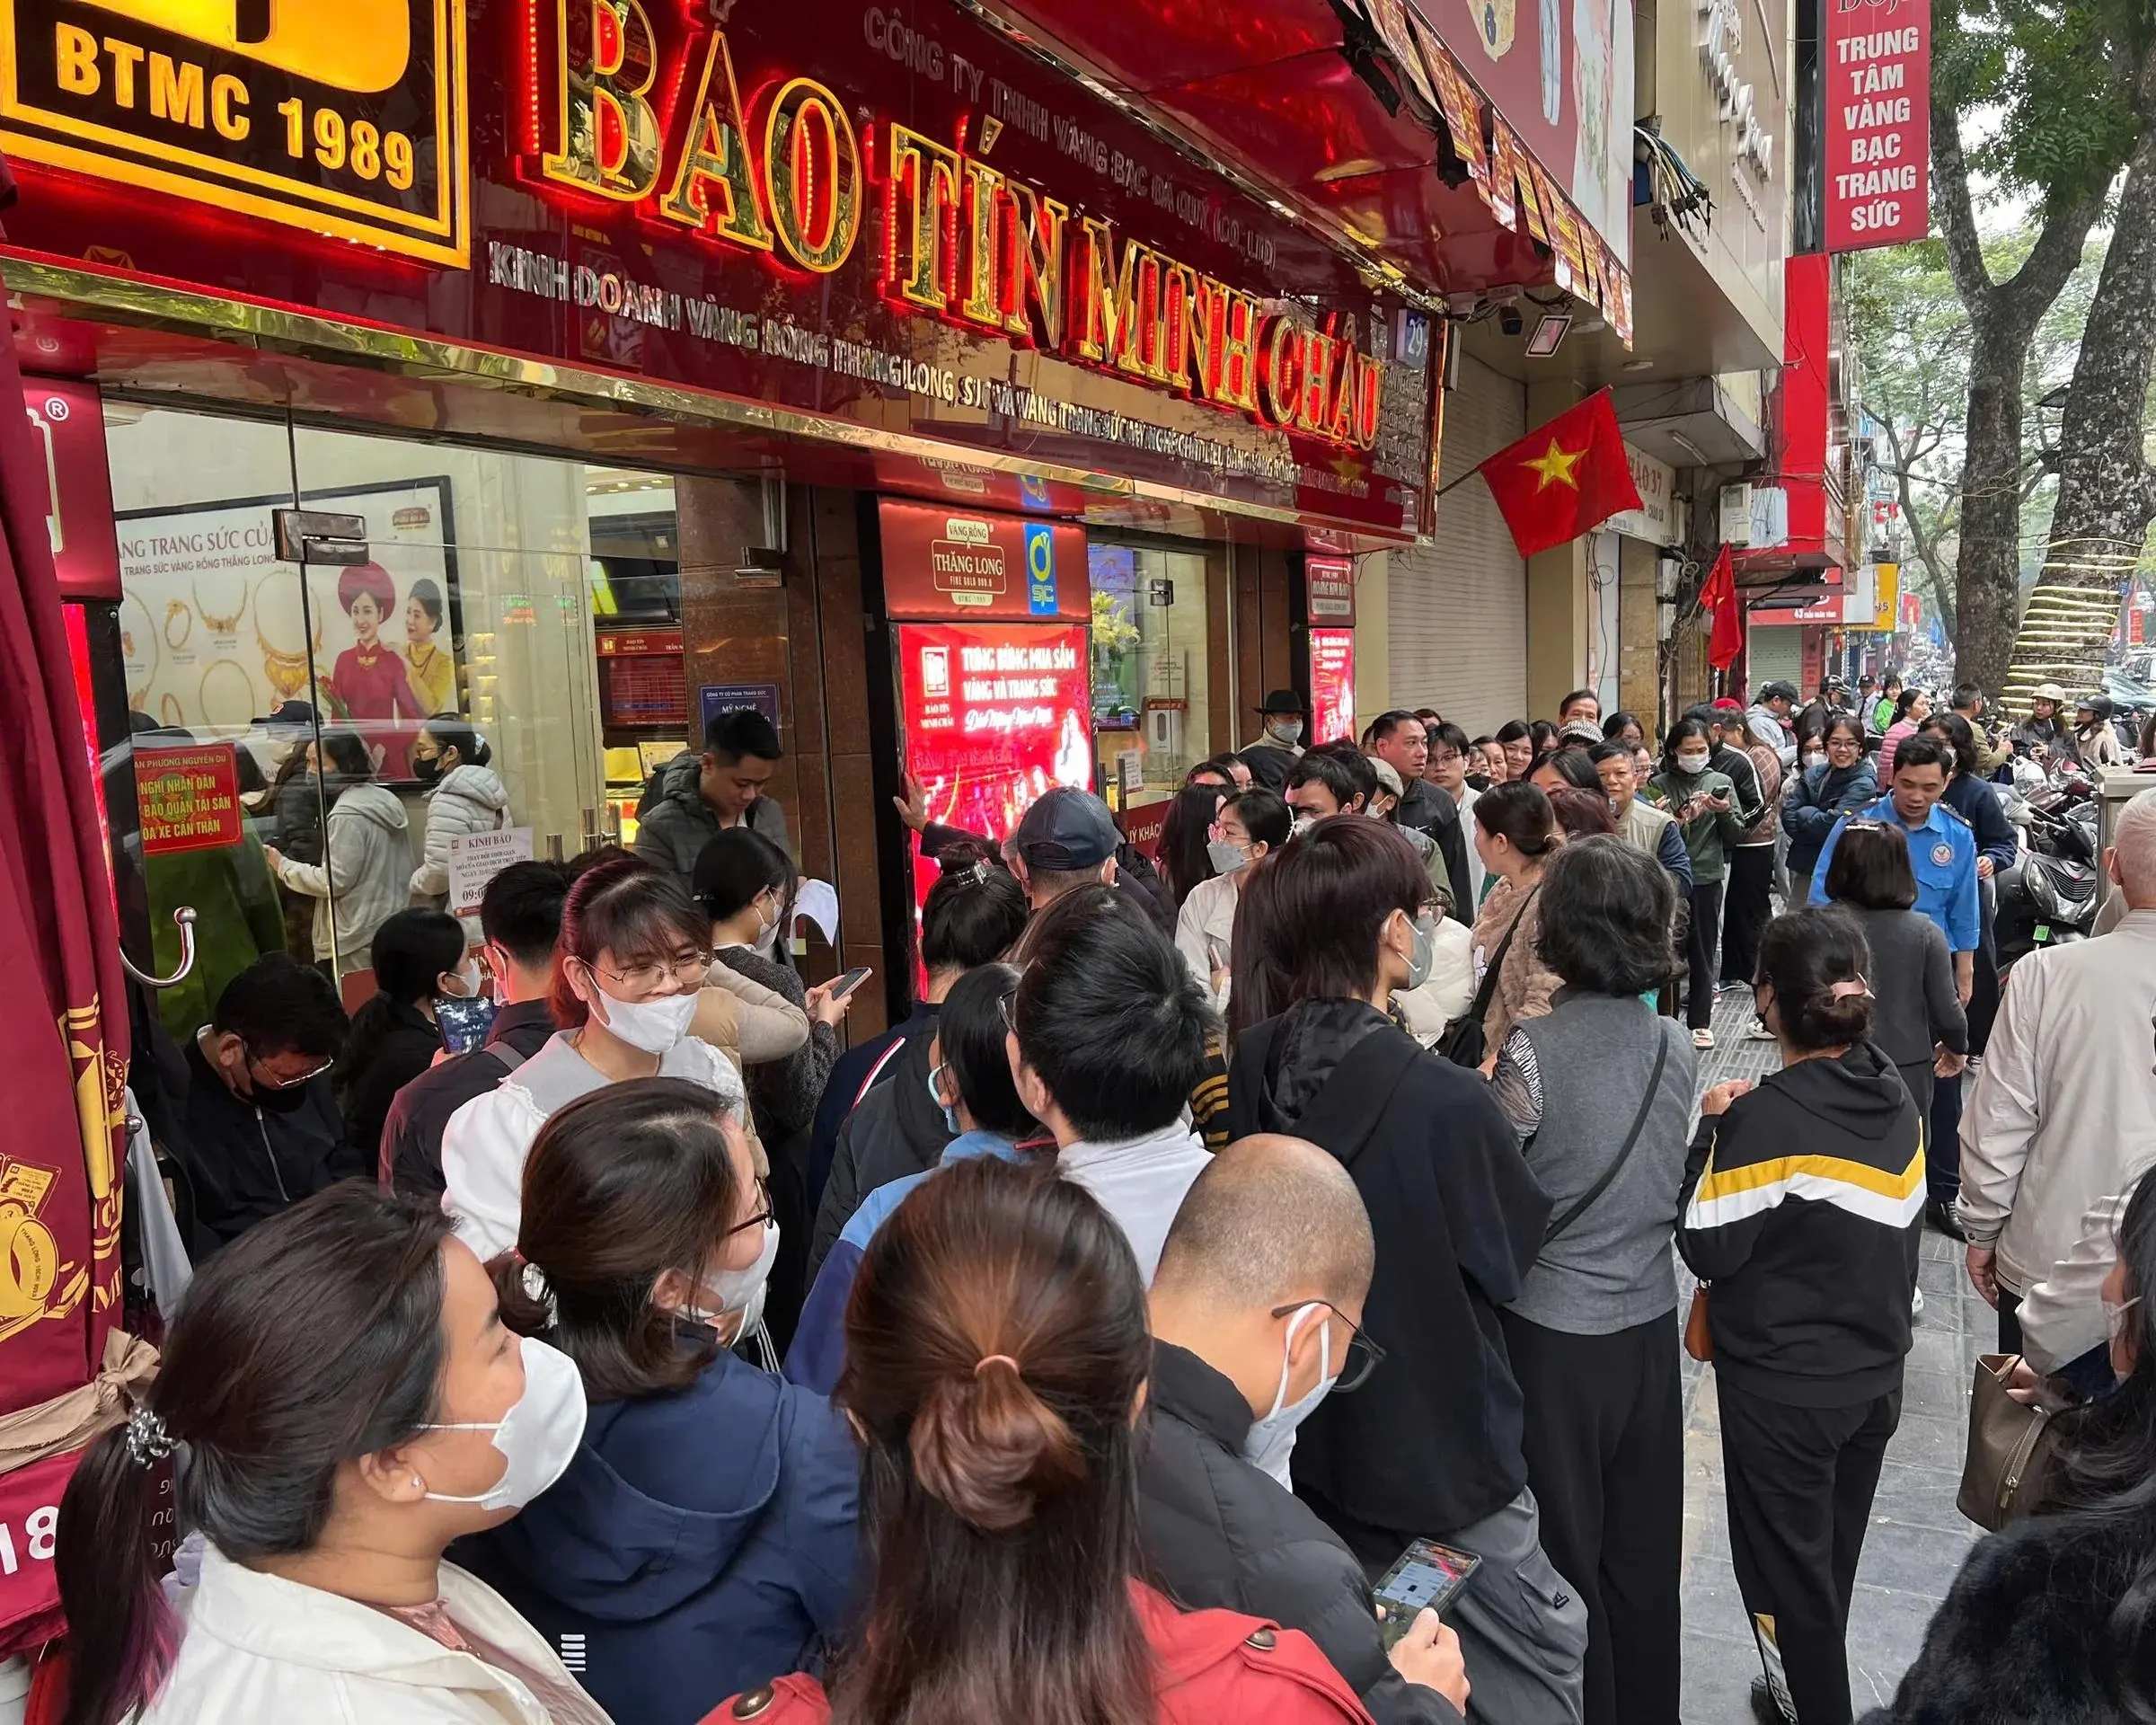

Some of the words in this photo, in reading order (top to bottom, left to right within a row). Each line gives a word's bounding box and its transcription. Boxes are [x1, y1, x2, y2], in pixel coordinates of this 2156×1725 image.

[1836, 26, 1920, 64] TRUNG
[1850, 63, 1904, 95] TÂM
[55, 21, 250, 141] BTMC
[278, 96, 415, 191] 1989
[864, 6, 944, 81] CÔNG
[951, 53, 985, 102] TY
[989, 78, 1048, 142] TNHH
[1053, 114, 1108, 174] VÀNG
[1111, 150, 1148, 198] BẠC
[1843, 97, 1911, 131] VÀNG
[1851, 133, 1901, 166] BẠC
[1835, 164, 1916, 199] TRANG
[1850, 200, 1900, 232] SỨC
[890, 115, 1068, 349] TÍN
[1079, 216, 1263, 412] MINH
[1268, 311, 1385, 451] CHÂU
[488, 240, 570, 303] KINH
[574, 265, 681, 331] DOANH
[685, 293, 756, 351] VÀNG
[761, 313, 827, 367] RỒNG
[834, 338, 901, 387] THĂNG
[1016, 386, 1057, 426] VÀNG
[1058, 402, 1101, 437] TRANG
[1407, 317, 1424, 358] 29
[149, 534, 203, 557] TRANG
[208, 525, 241, 552] SỨC
[949, 524, 968, 537] VÀNG
[968, 526, 987, 540] RỒNG
[124, 565, 152, 576] TRANG
[153, 562, 170, 574] SỨC
[171, 561, 195, 574] VÀNG
[221, 554, 251, 569] THĂNG
[252, 553, 277, 566] LONG
[934, 550, 974, 573] THĂNG
[975, 557, 1003, 576] LONG
[182, 753, 214, 765] NGUYỄN
[216, 755, 226, 763] DU
[140, 780, 164, 796] NGHỊ
[167, 774, 194, 792] NHÂN
[197, 773, 216, 790] DÂN
[166, 796, 193, 815] QUẢN
[213, 792, 231, 809] SẢN
[159, 824, 172, 839] XE
[173, 818, 194, 836] CẨN
[197, 818, 221, 836] THẬN
[468, 836, 491, 849] KÍNH
[493, 833, 512, 845] BÁO
[462, 888, 485, 902] 09:0
